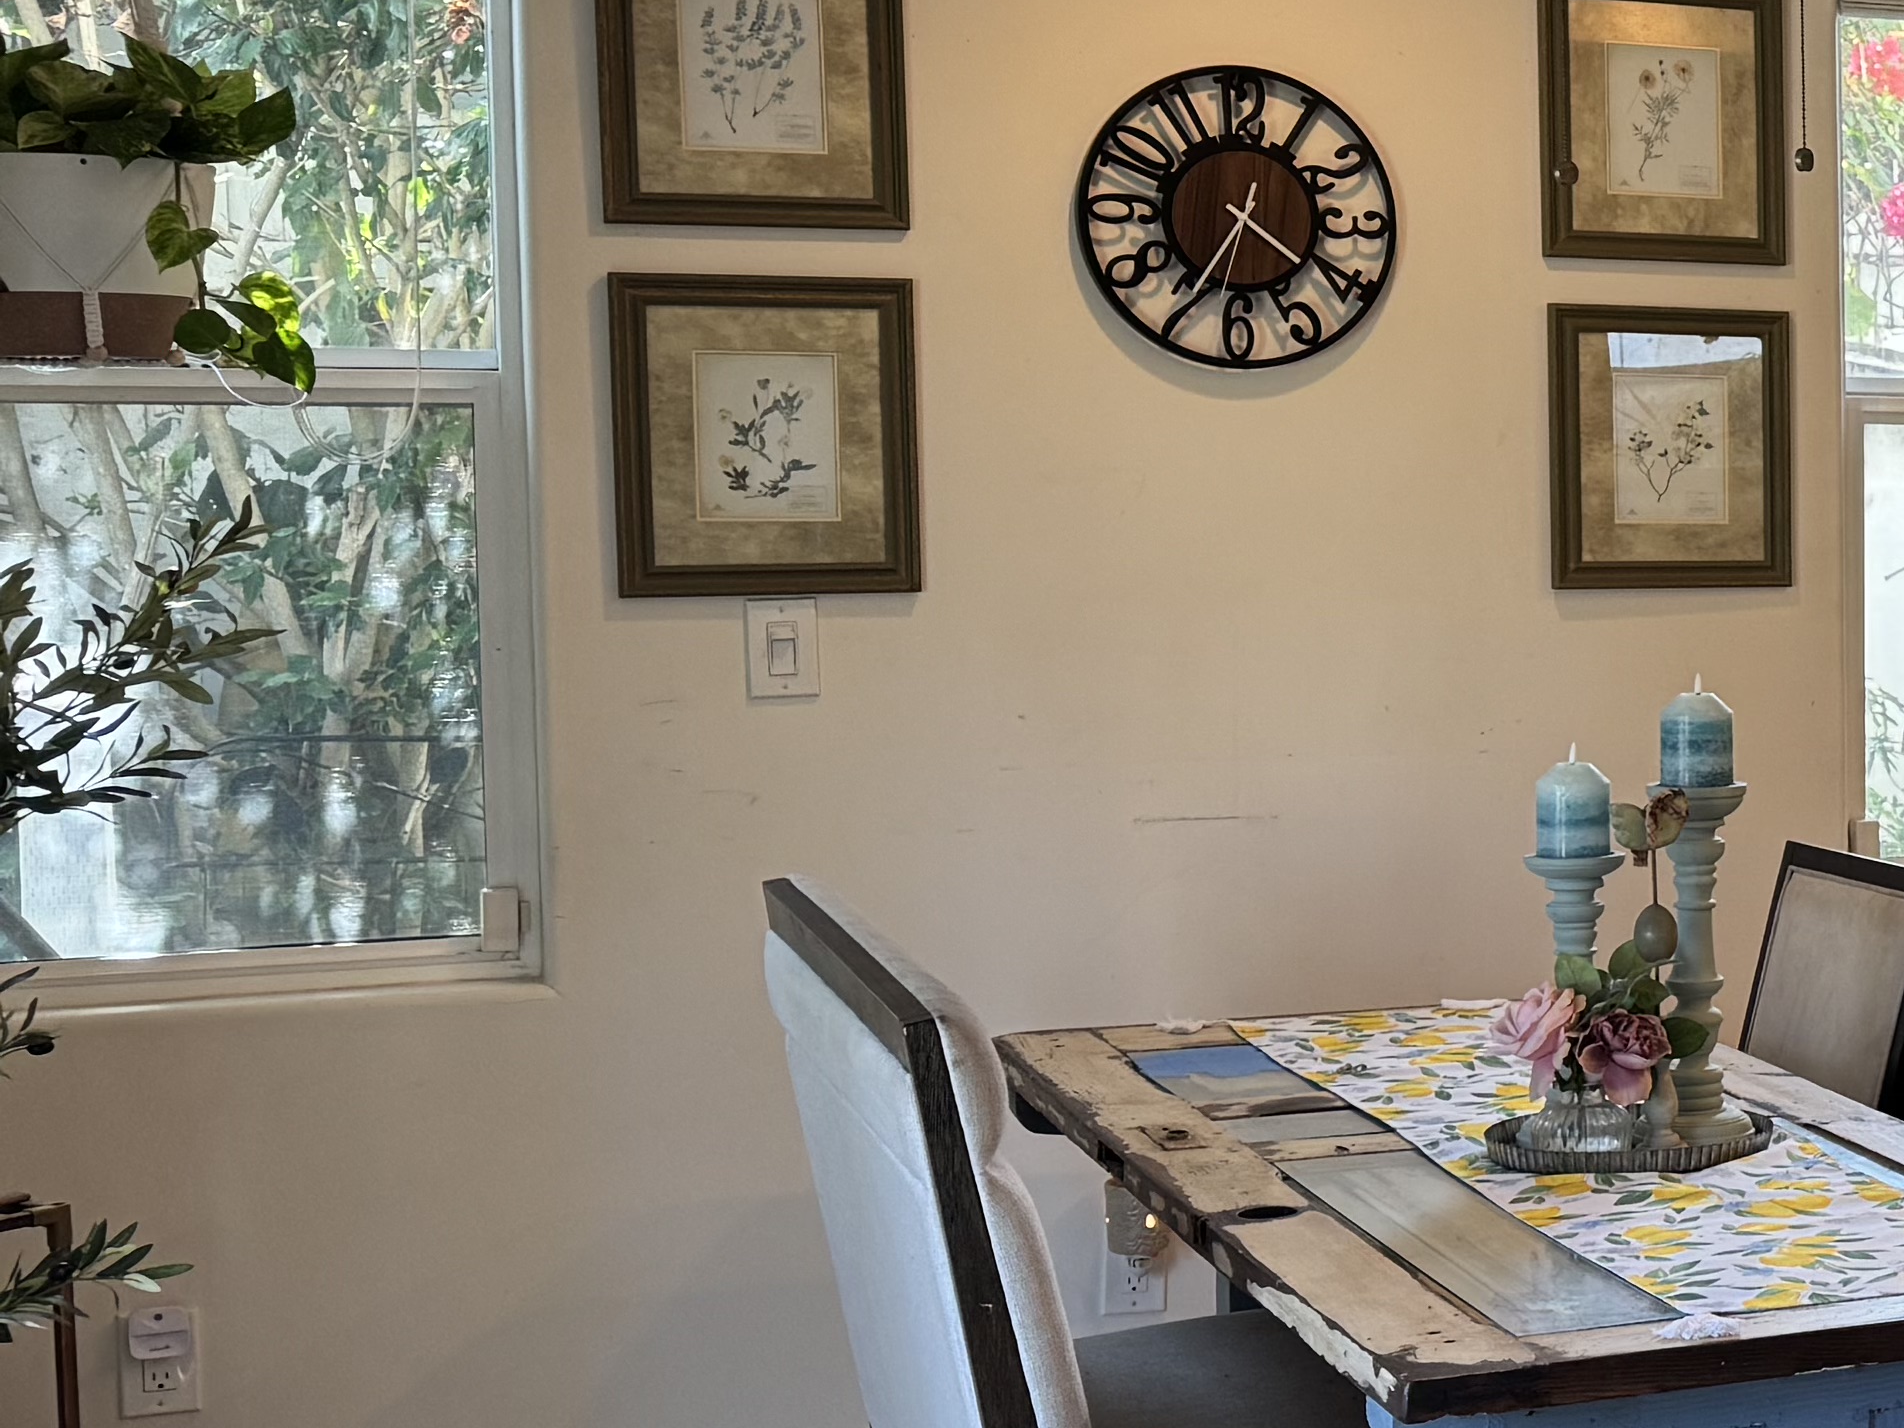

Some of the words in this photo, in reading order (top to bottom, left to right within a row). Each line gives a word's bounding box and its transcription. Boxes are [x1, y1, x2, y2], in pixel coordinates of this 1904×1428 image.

[1148, 81, 1219, 159] 11
[1213, 73, 1265, 145] 12
[1270, 94, 1323, 164] 1
[1099, 125, 1176, 192] 10
[1298, 143, 1369, 194] 2
[1087, 194, 1161, 225] 9
[1319, 207, 1388, 239] 3
[1105, 240, 1172, 288] 8
[1311, 253, 1378, 304] 4
[1161, 268, 1215, 341] 7
[1222, 292, 1255, 361] 6
[1268, 278, 1322, 347] 5
